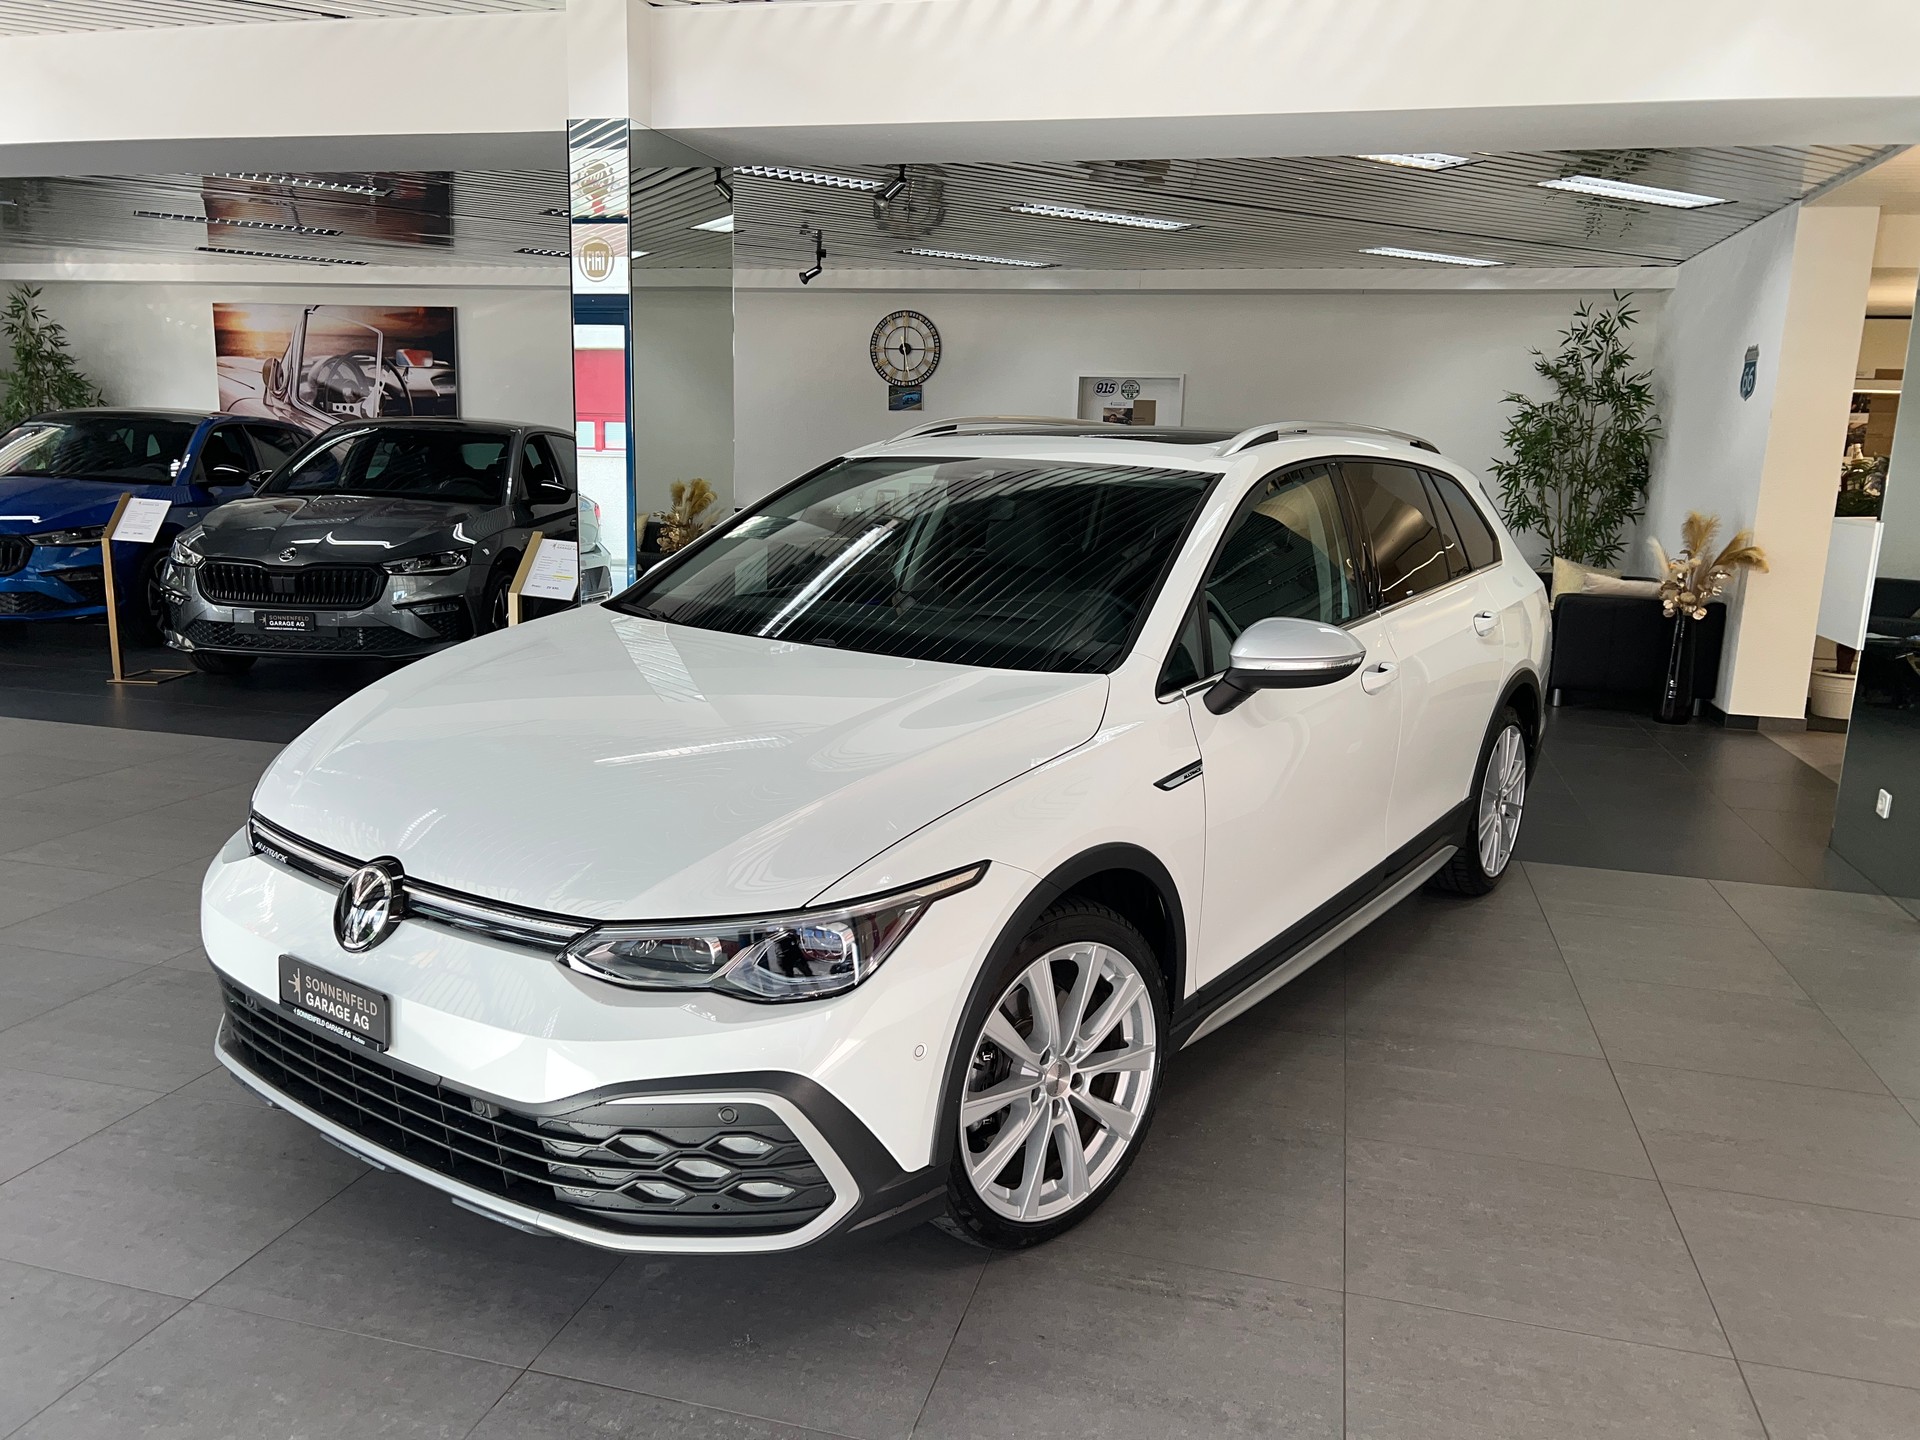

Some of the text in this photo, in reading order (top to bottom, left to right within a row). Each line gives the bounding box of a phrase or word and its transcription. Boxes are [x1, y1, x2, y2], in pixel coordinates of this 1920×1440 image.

[586, 251, 607, 271] FIAT
[1095, 382, 1116, 394] 915
[1743, 366, 1755, 392] 66
[305, 975, 378, 1016] SONNENFELD
[296, 1009, 326, 1027] SONNENFELD
[325, 1021, 344, 1036] GARAGE
[344, 1030, 352, 1039] AG
[305, 992, 370, 1031] GARAGE AG
